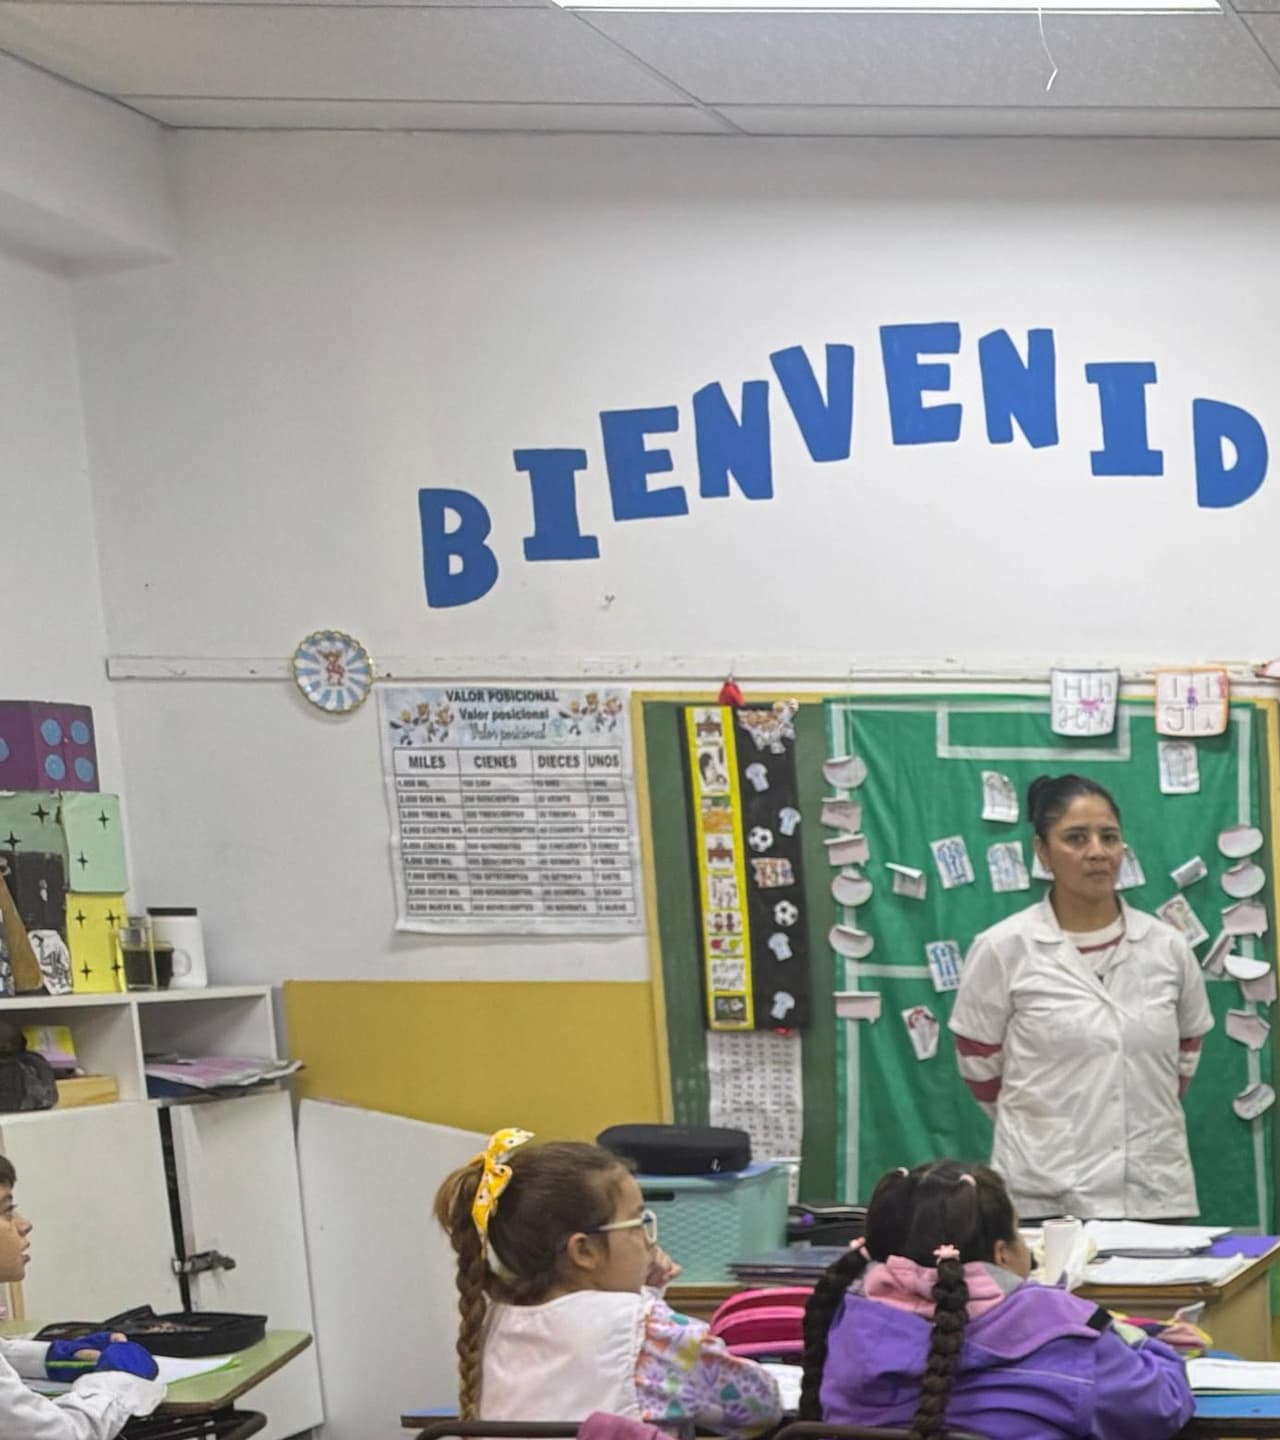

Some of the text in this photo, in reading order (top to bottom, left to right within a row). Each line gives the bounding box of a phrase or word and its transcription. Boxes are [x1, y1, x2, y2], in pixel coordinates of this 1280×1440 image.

[446, 689, 559, 702] VALOR POSICIONAL
[459, 707, 549, 722] Valor posicional
[409, 755, 446, 769] MILES
[474, 755, 517, 769] CIENES
[538, 755, 580, 768] DIECES
[588, 754, 619, 768] UNOS
